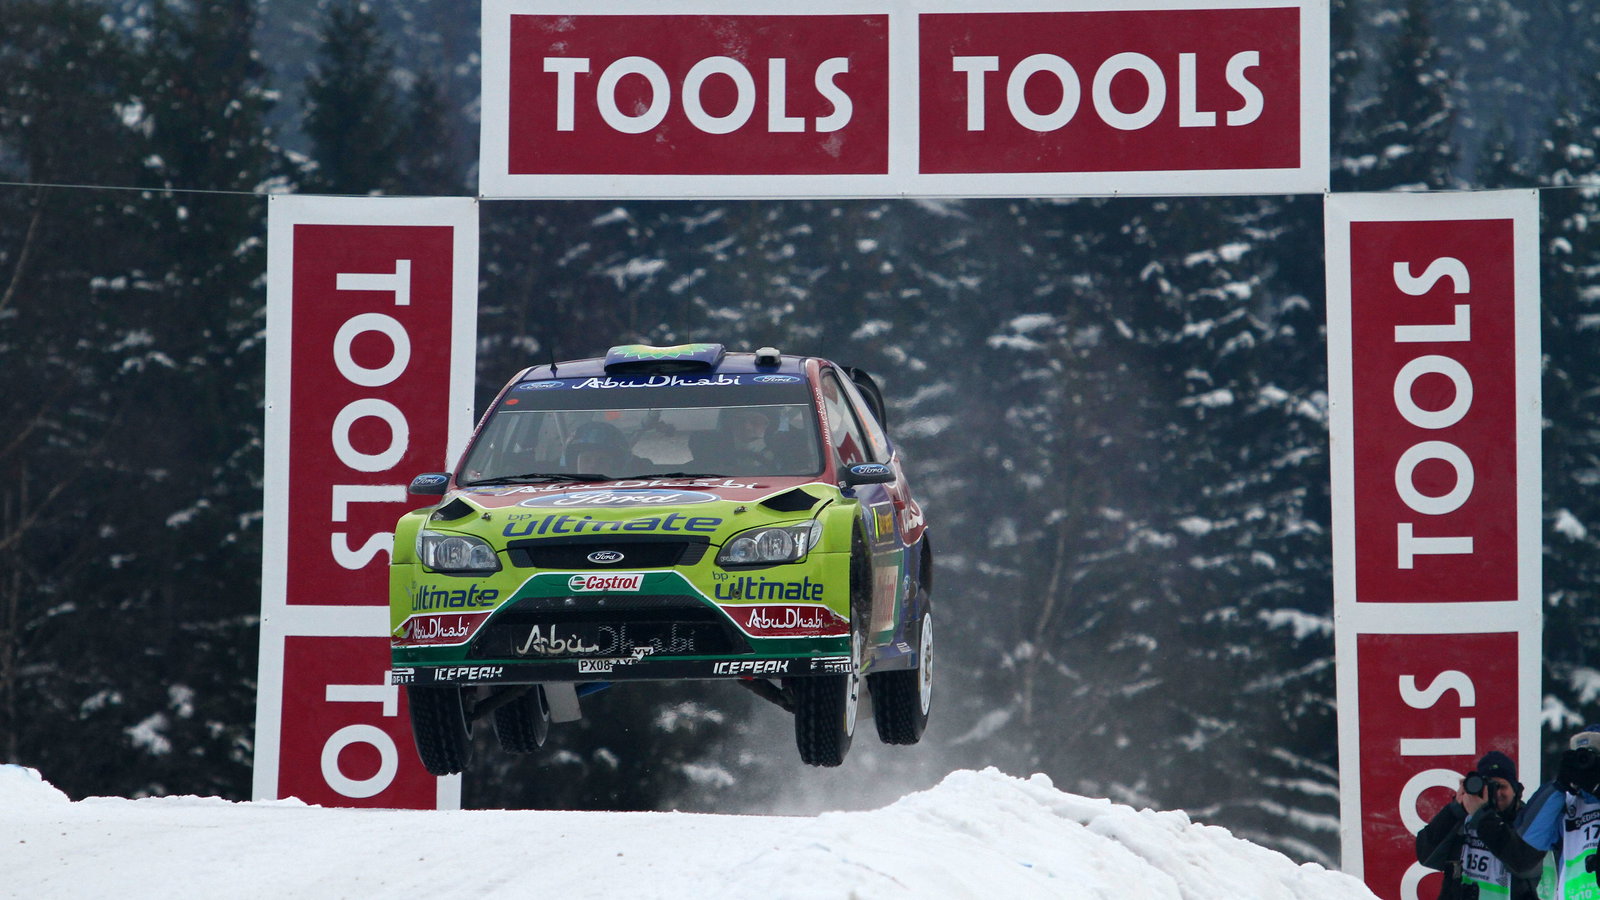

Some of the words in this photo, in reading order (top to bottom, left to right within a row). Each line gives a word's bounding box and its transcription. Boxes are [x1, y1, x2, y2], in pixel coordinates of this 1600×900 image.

[543, 55, 853, 135] TOOLS
[952, 50, 1264, 133] TOOLS
[331, 259, 411, 571] TOOLS
[1393, 256, 1475, 570] TOOLS
[859, 465, 884, 474] Ford
[414, 474, 438, 485] Ford
[552, 491, 684, 505] Ford
[502, 513, 723, 537] ultimate
[508, 513, 532, 521] bp
[585, 574, 640, 590] Castrol
[712, 571, 729, 582] bp
[714, 576, 824, 601] ultimate
[411, 583, 499, 611] ultimate
[433, 666, 504, 681] ICEPEAK
[580, 660, 611, 672] PX08
[713, 659, 790, 675] ICEPEAK
[1466, 853, 1490, 873] 156
